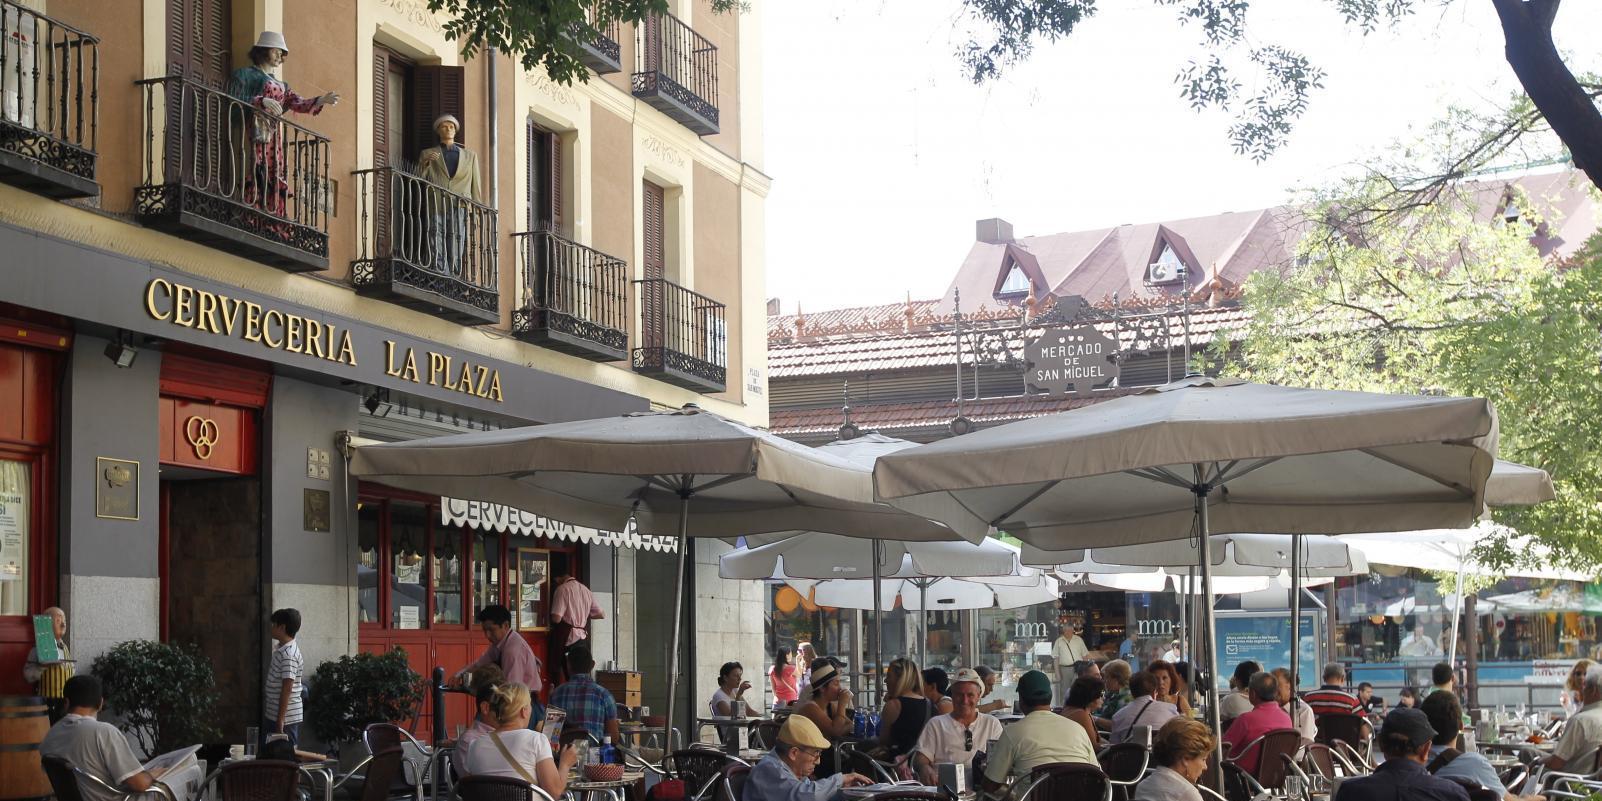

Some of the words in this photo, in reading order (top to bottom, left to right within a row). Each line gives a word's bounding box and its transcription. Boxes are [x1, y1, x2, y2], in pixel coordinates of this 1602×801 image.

[145, 278, 358, 366] CERVECERIA
[385, 340, 420, 383] LA
[427, 351, 504, 402] PLAZA
[1041, 343, 1102, 358] MERCADO
[1064, 357, 1080, 366] DE
[1037, 369, 1059, 381] SAN
